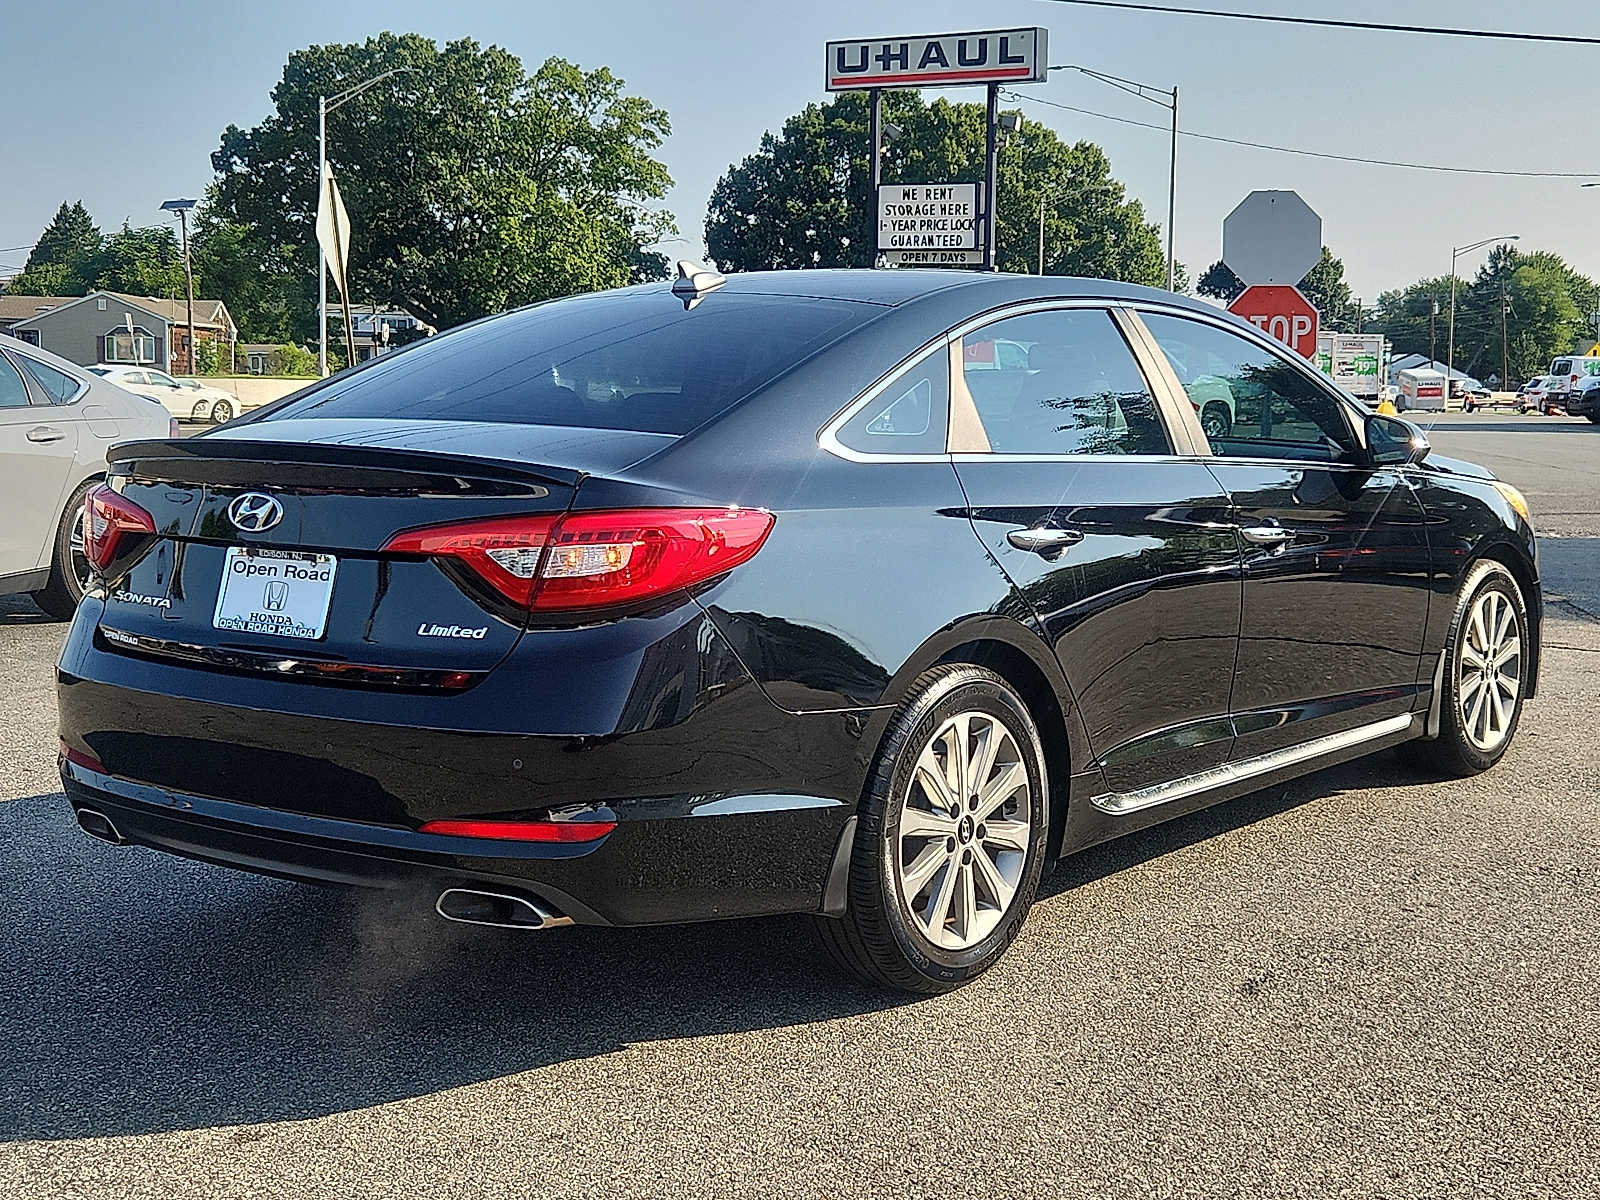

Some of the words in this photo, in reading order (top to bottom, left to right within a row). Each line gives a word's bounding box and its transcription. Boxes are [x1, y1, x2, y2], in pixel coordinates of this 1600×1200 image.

[902, 188, 918, 200] WE
[925, 187, 954, 200] RENT
[885, 203, 936, 216] STORAGE
[940, 203, 969, 216] HERE
[891, 219, 917, 231] YEAR
[919, 219, 948, 231] PRICE
[950, 218, 975, 231] LOCK
[890, 234, 963, 247] GUARANTEED
[901, 252, 929, 262] OPEN
[932, 253, 938, 262] 7
[940, 252, 967, 262] DAYS
[1241, 315, 1312, 350] TOP
[233, 560, 278, 578] Open
[284, 564, 331, 582] Road
[113, 590, 172, 609] SONATA
[249, 612, 294, 626] HONDA
[219, 618, 246, 630] OPEN
[247, 621, 276, 633] ROAD
[278, 624, 315, 637] HONDA
[417, 623, 488, 639] Limited
[119, 633, 139, 645] ROAD
